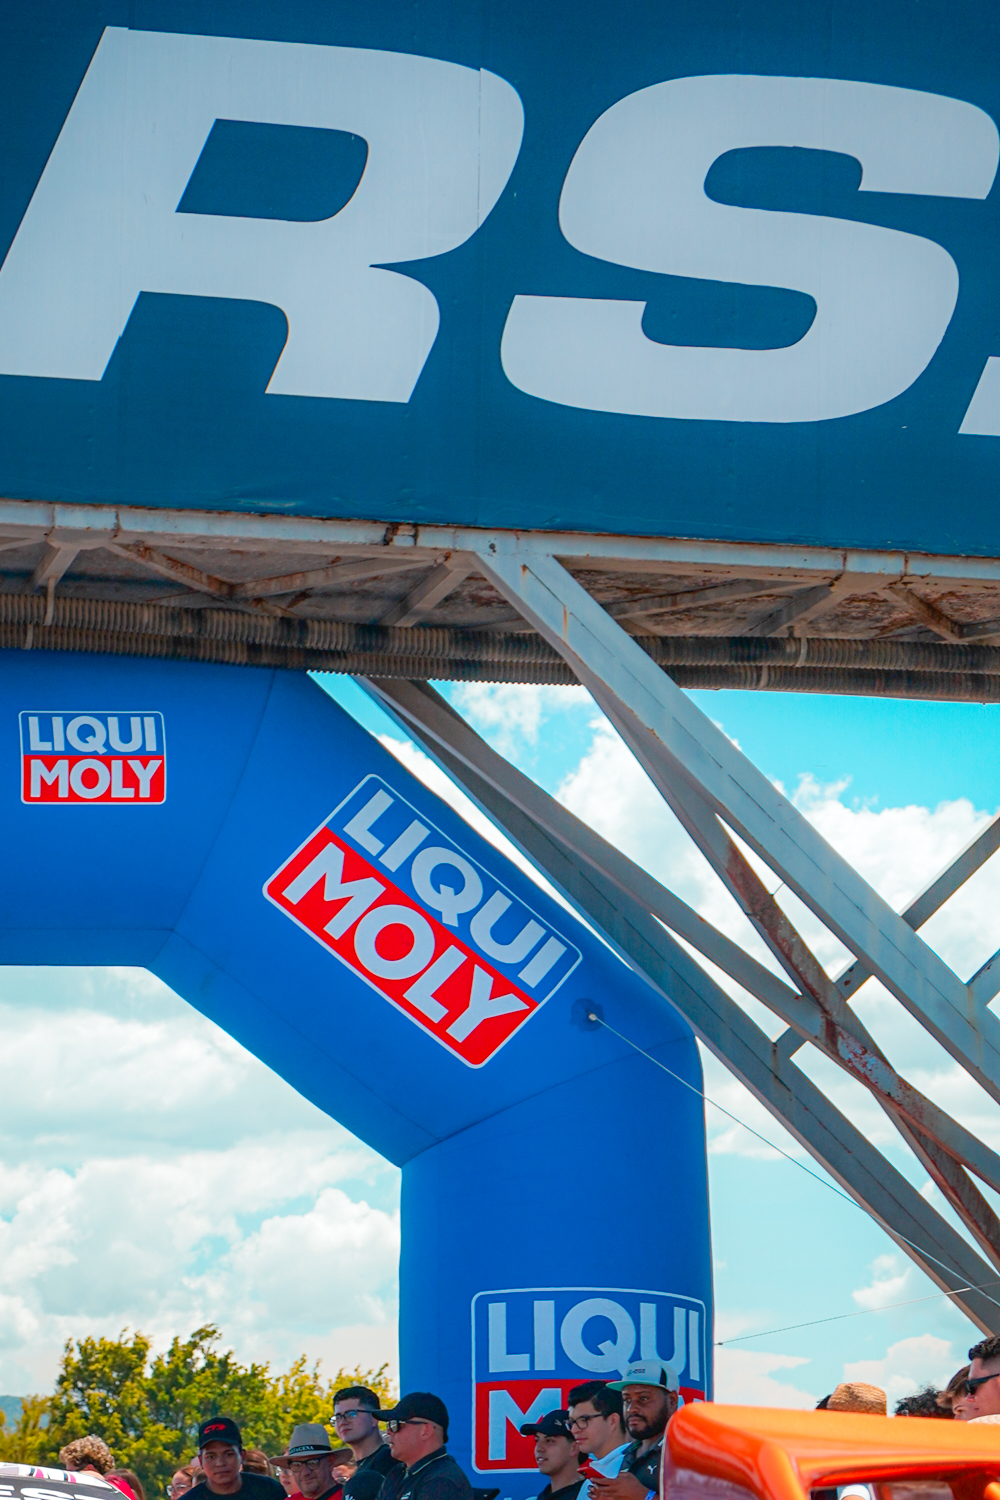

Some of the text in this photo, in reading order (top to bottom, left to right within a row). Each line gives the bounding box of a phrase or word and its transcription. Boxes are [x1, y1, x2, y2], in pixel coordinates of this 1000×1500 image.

[28, 715, 157, 755] LIQUI
[30, 758, 162, 799] MOLY
[342, 789, 567, 989] LIQUI
[281, 841, 530, 1044] MOLY
[488, 1297, 699, 1382] LIQUI
